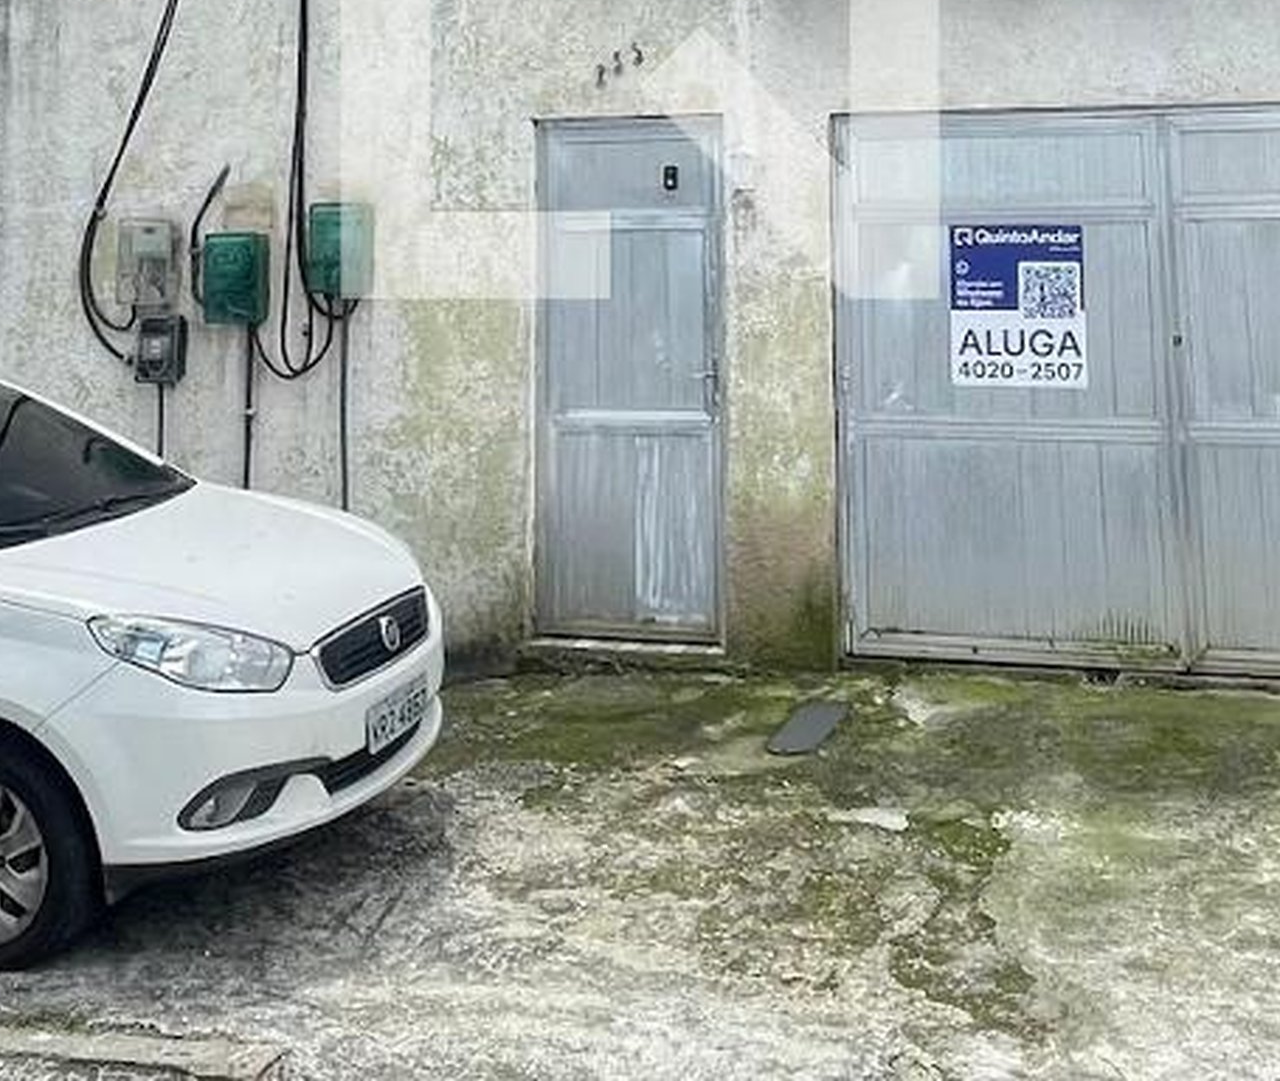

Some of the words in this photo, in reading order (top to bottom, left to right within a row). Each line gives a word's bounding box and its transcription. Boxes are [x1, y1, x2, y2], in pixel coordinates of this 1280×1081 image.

[975, 228, 1080, 244] QuintoAndar
[959, 329, 1082, 357] ALUGA
[958, 361, 1083, 381] 4020-2507
